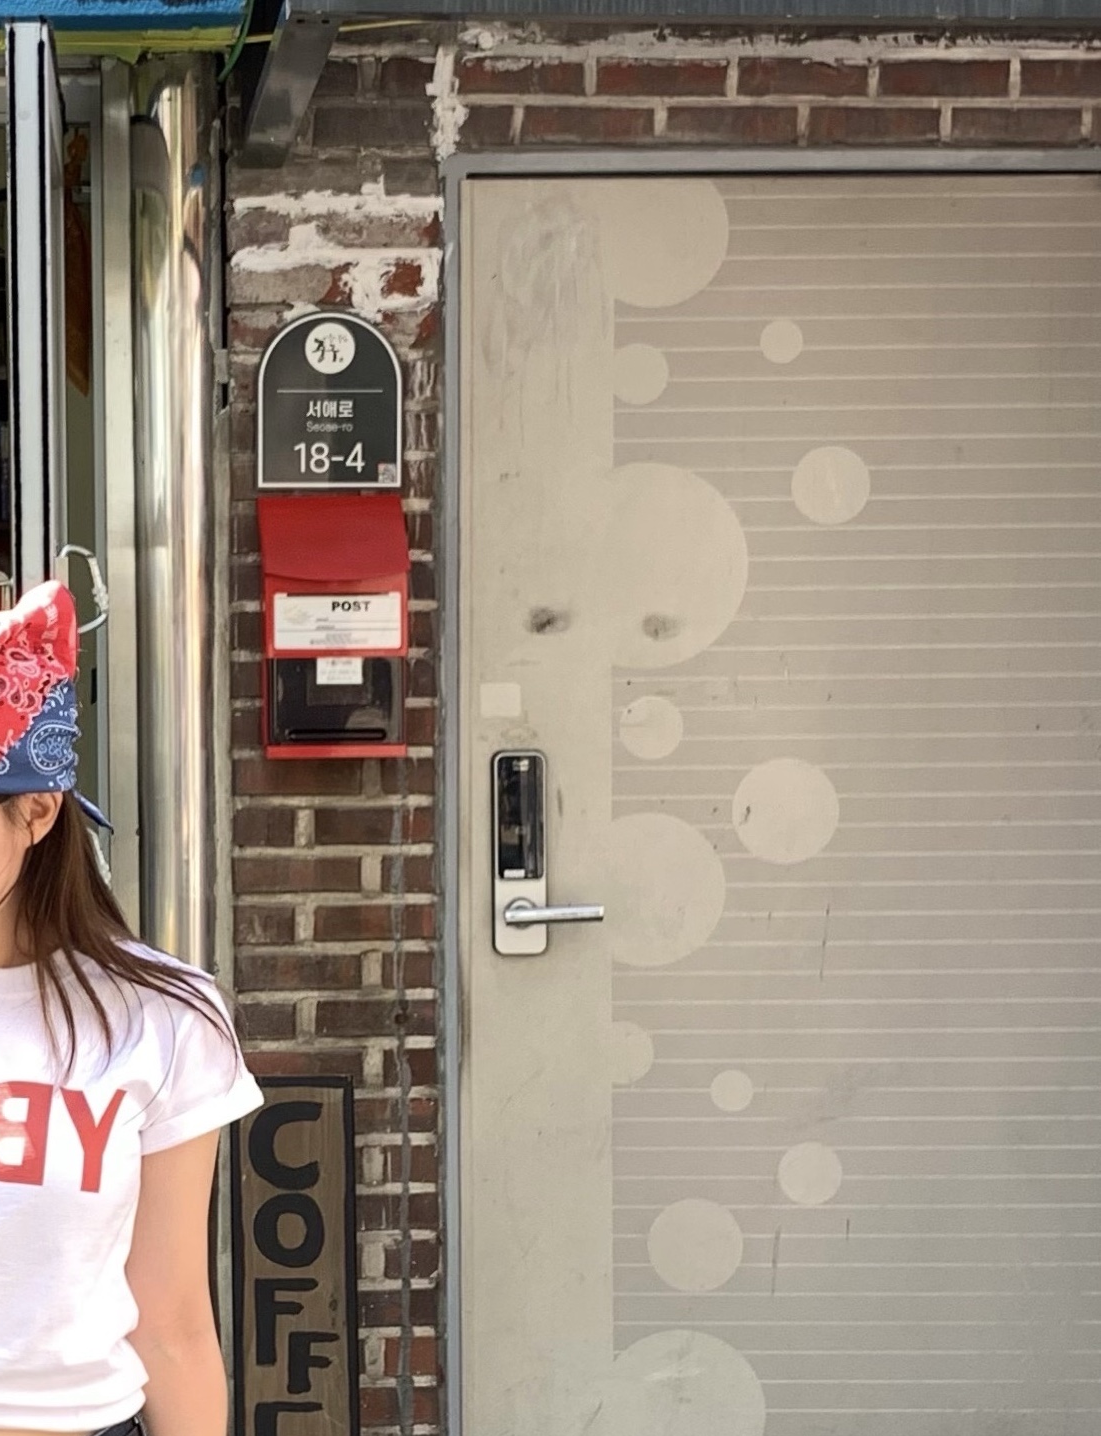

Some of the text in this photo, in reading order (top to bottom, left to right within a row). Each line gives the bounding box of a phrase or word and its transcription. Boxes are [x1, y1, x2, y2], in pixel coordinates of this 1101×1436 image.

[306, 400, 354, 418] 서애로
[306, 421, 354, 432] Seoae-ro
[293, 442, 365, 473] 18-4
[331, 601, 371, 612] POST
